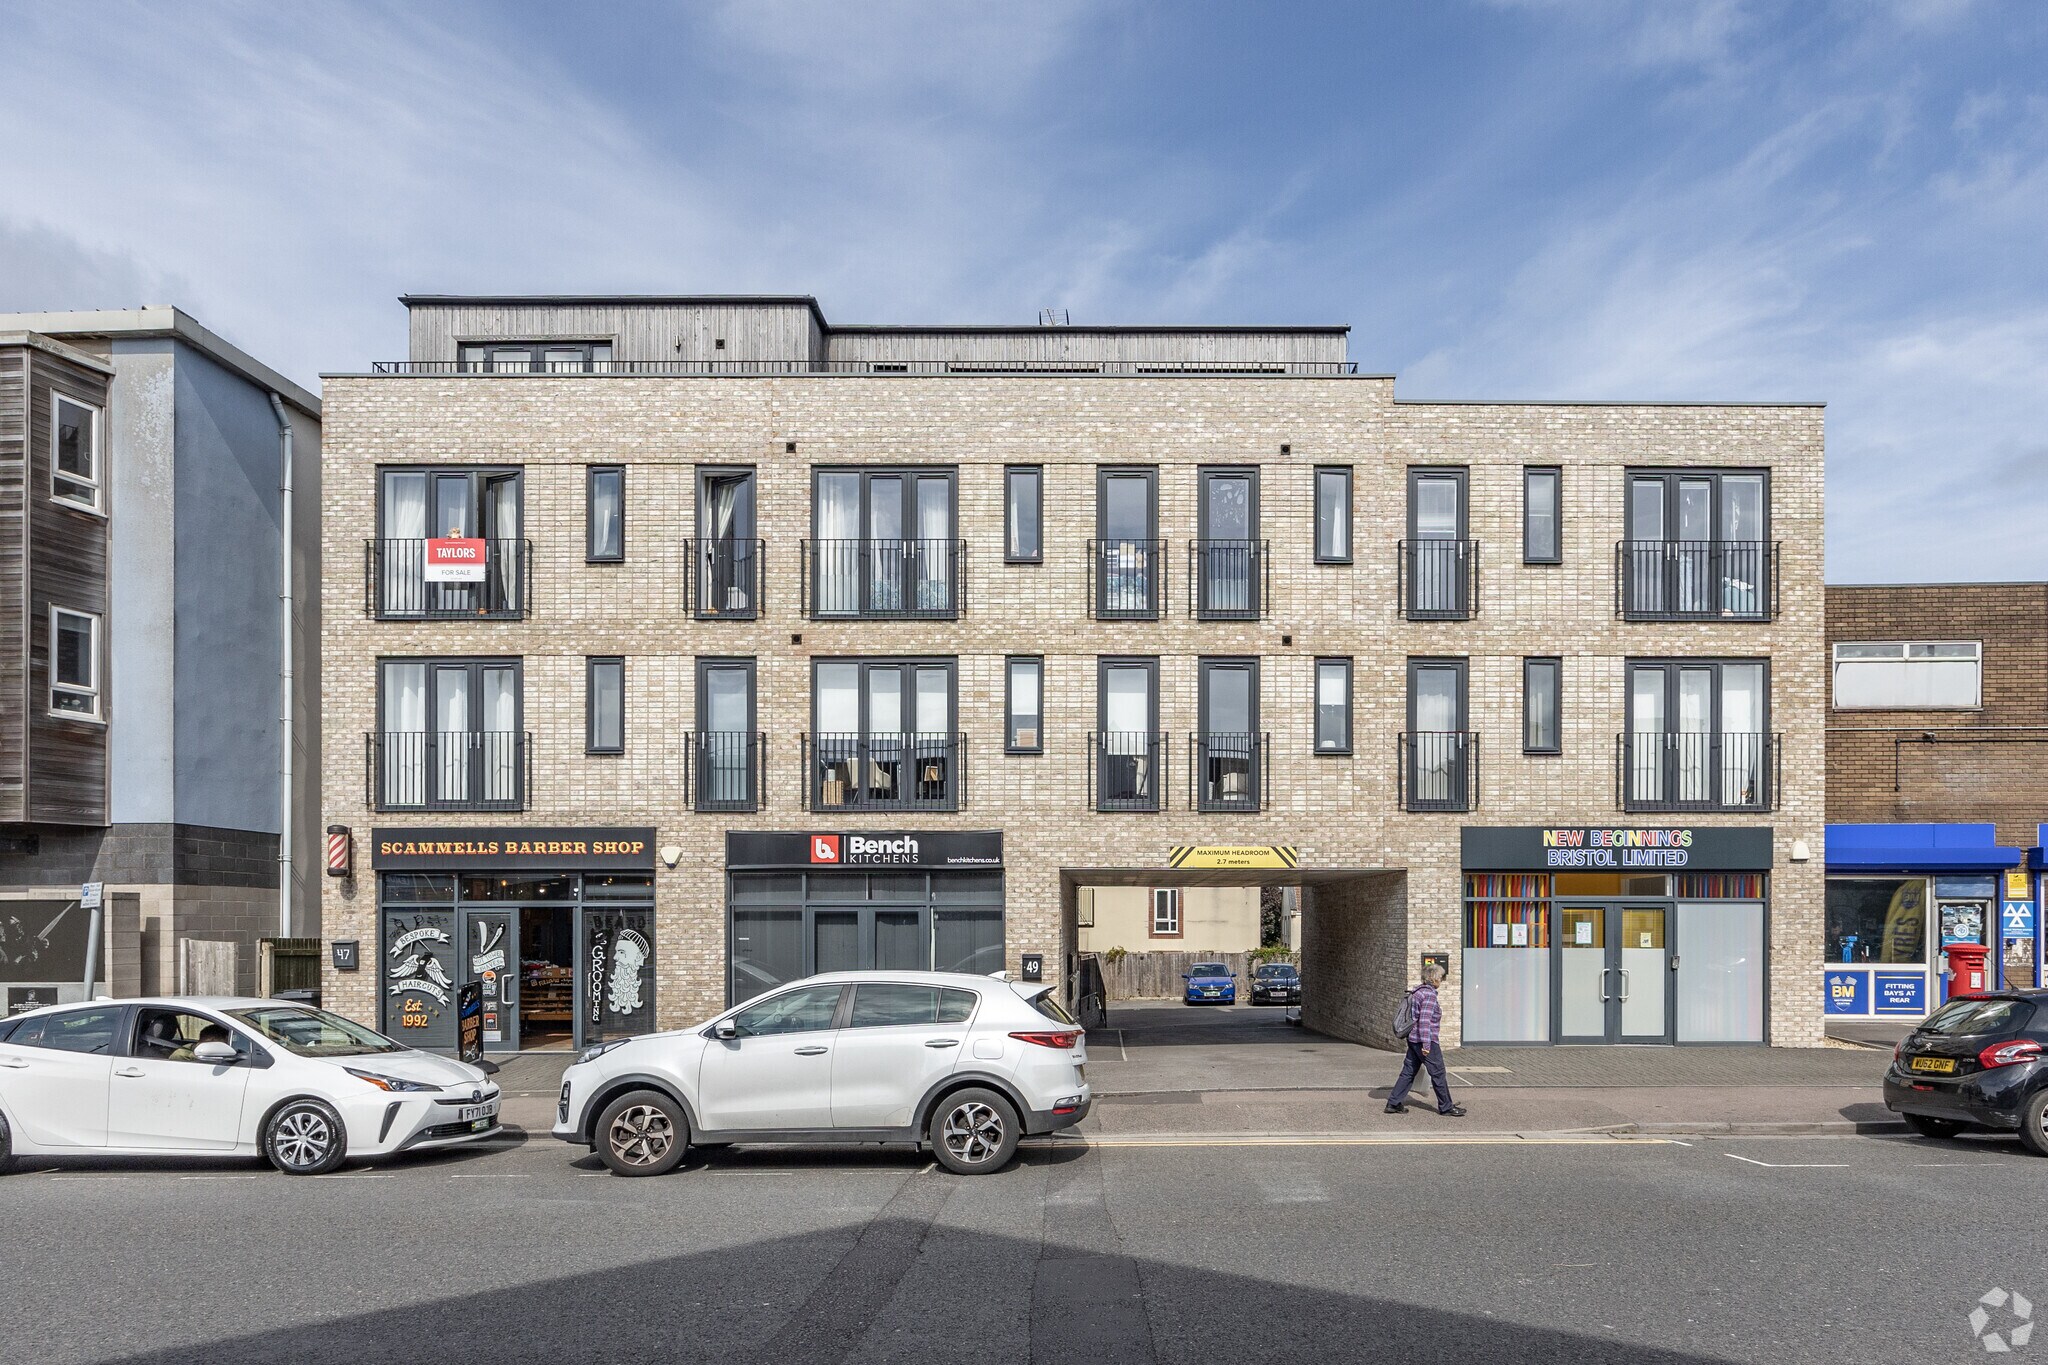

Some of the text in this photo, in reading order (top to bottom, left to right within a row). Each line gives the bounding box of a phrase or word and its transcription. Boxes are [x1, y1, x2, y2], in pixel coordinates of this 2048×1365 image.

[436, 547, 476, 559] TAYLORS
[850, 835, 919, 854] Bench
[1543, 829, 1693, 847] NEW BEGINNINGS
[381, 840, 645, 856] SCAMMELLS BARBER SHOP
[850, 854, 919, 864] KITCHENS
[947, 856, 1000, 864] benchkitchens.co.uk
[1547, 849, 1689, 867] BRISTOL LIMITED
[400, 929, 436, 945] BESPOKE
[336, 948, 350, 960] 47
[1026, 960, 1039, 973] 49
[402, 981, 442, 997] HAIRCUTS
[591, 945, 606, 1022] GROOMING
[1831, 985, 1855, 998] BM
[404, 998, 423, 1012] Est
[402, 1014, 428, 1028] 1992
[463, 1028, 477, 1044] SHOP
[1933, 1060, 1951, 1070] GNF
[466, 1107, 481, 1119] FY71
